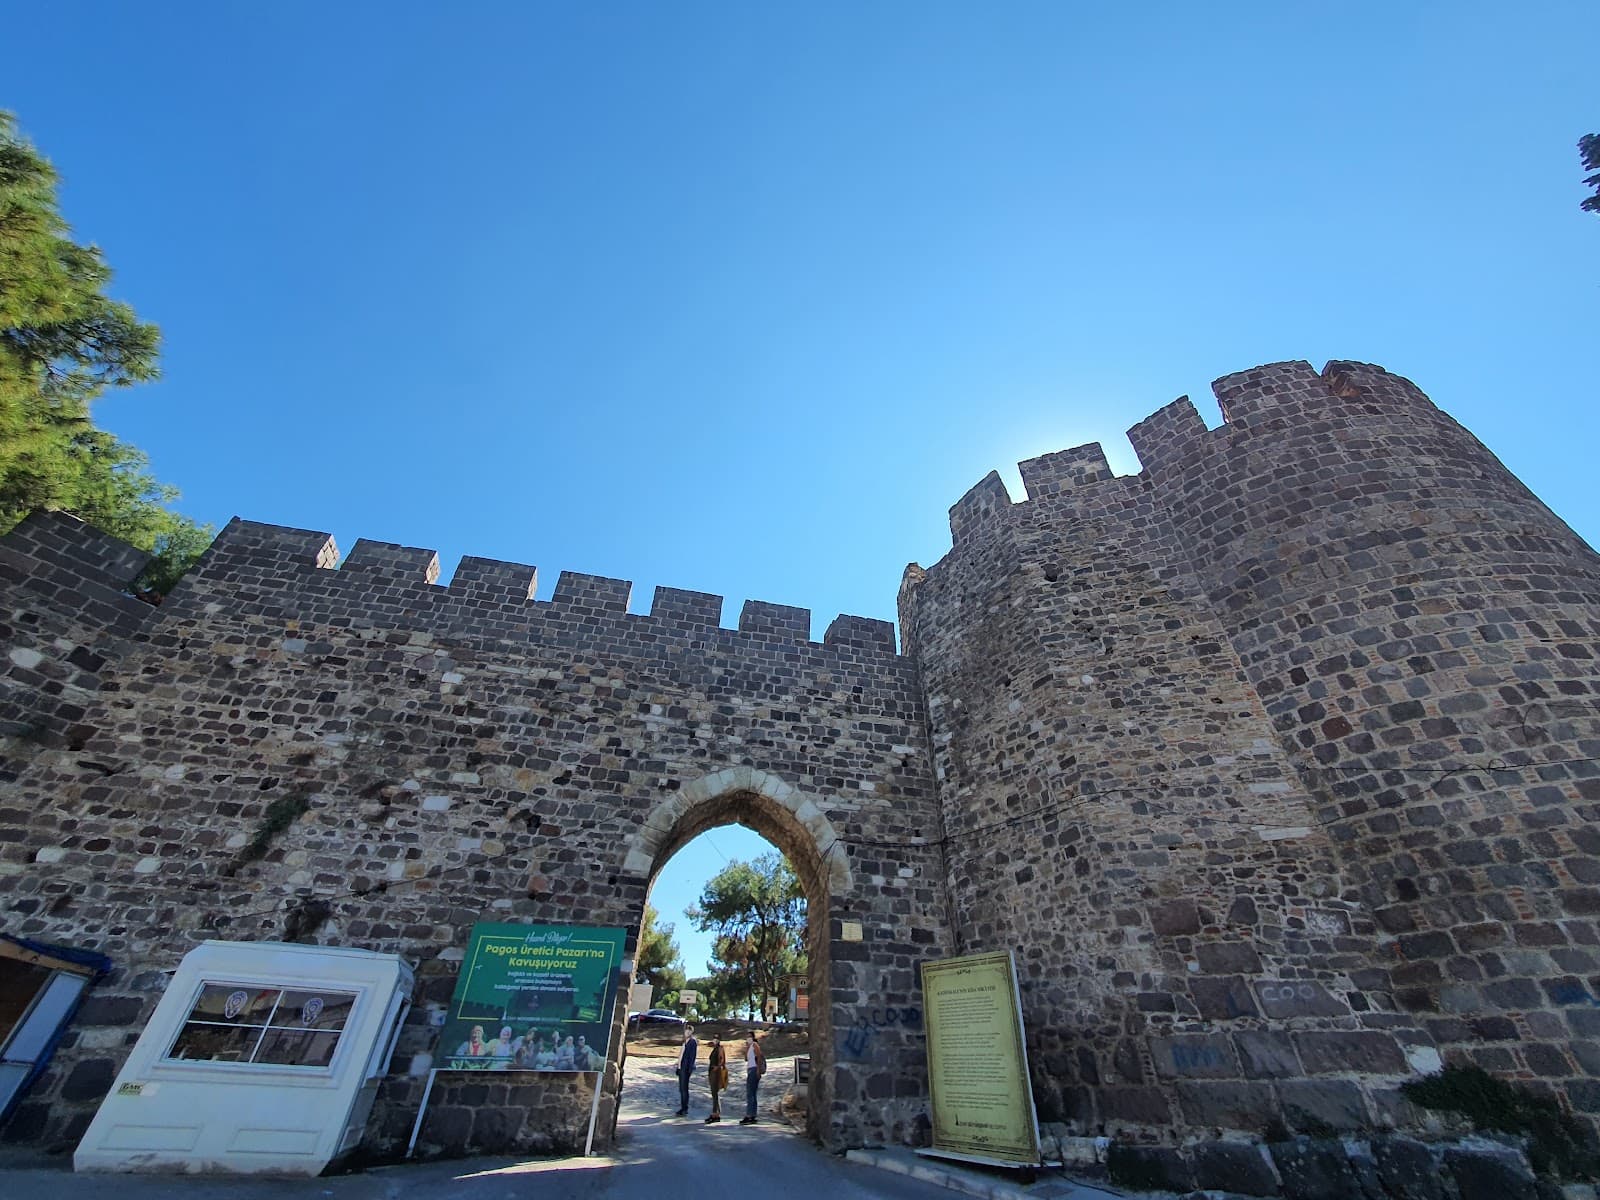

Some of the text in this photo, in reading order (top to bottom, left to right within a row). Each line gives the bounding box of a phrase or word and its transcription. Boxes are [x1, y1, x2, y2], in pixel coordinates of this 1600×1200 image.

[485, 944, 605, 958] Pagos Üretici Pazarı'na
[508, 957, 578, 970] Kavuşuyoruz
